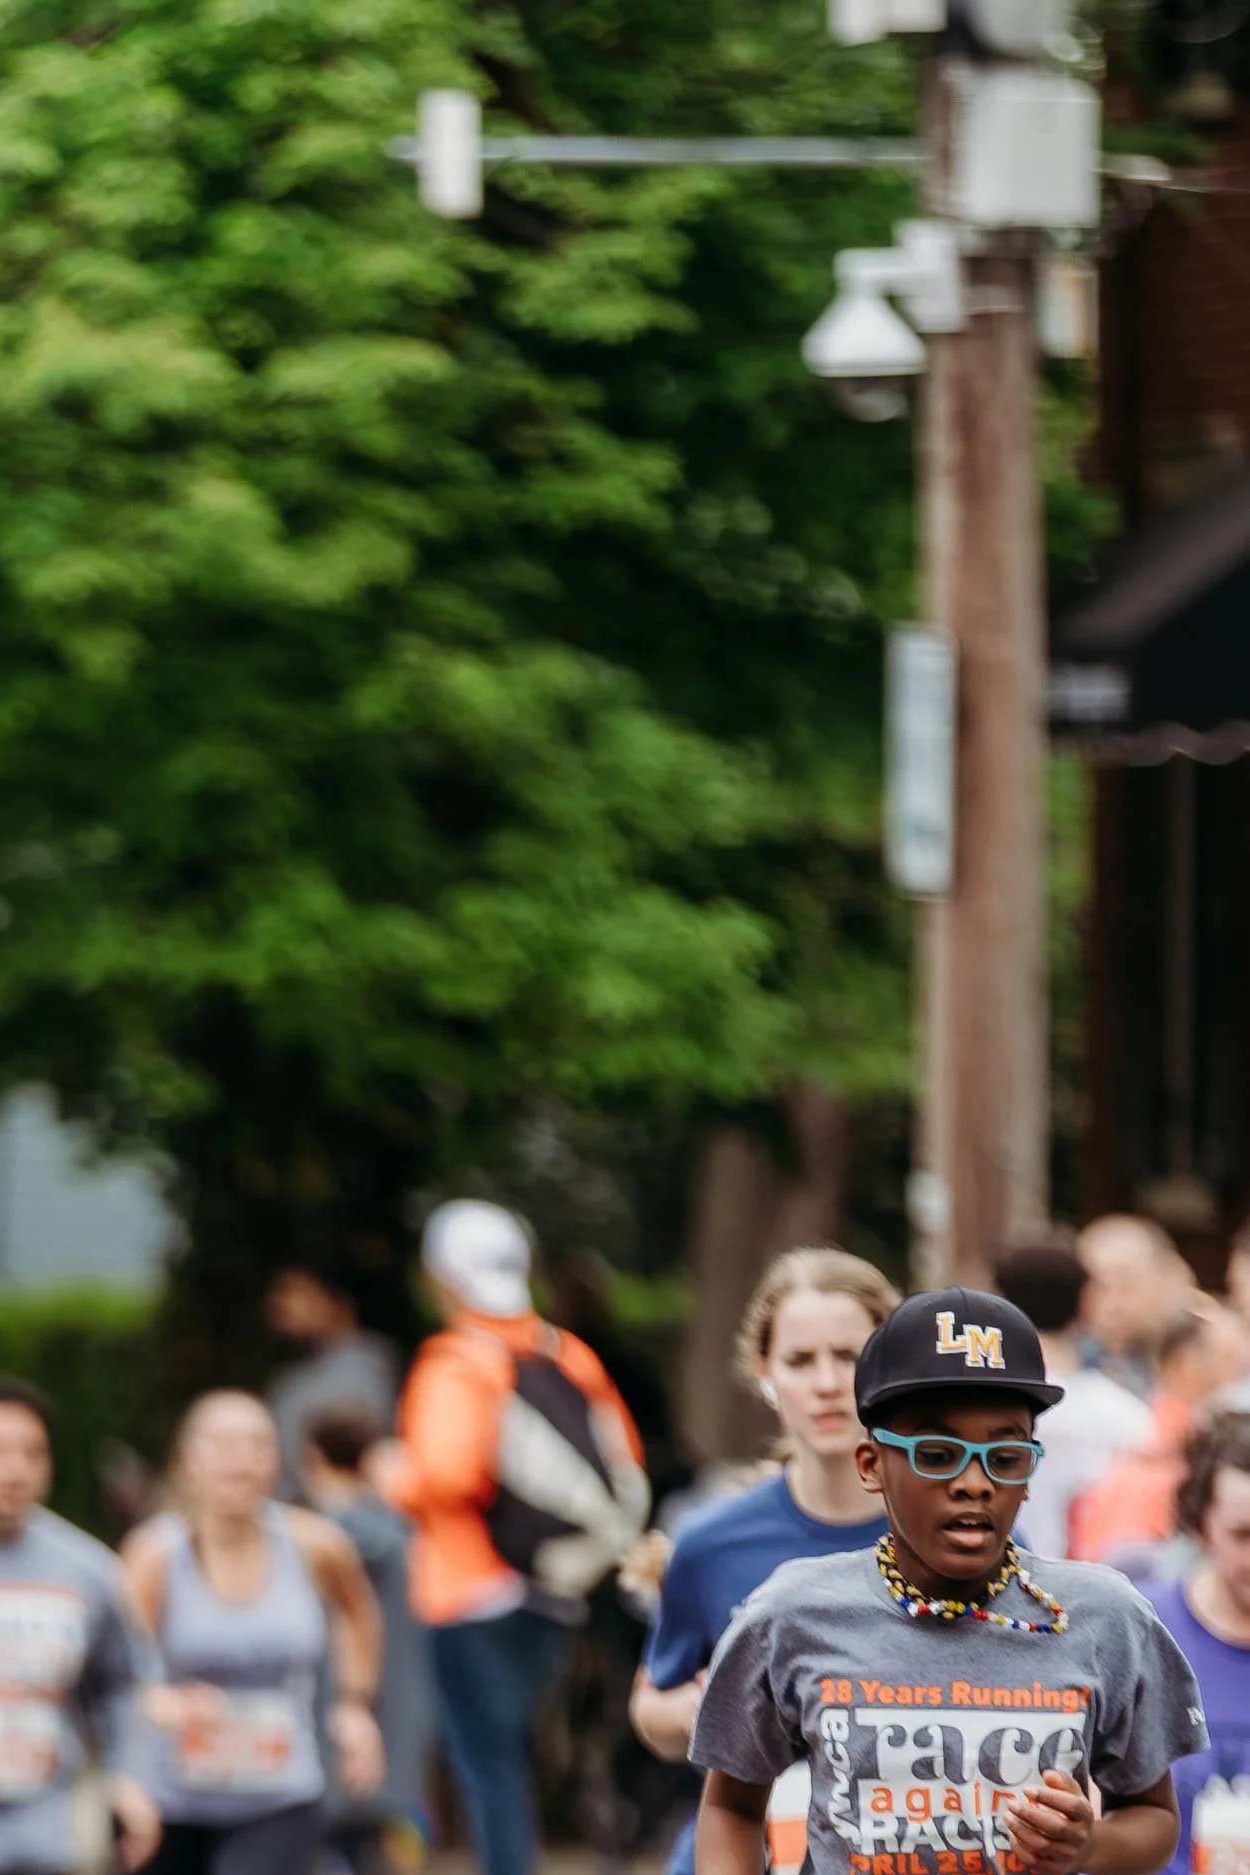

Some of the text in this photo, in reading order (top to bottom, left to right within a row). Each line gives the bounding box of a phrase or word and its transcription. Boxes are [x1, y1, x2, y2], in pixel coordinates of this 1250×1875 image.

[820, 1679, 853, 1705] 28
[859, 1679, 943, 1706] Years
[870, 1782, 1040, 1823] again
